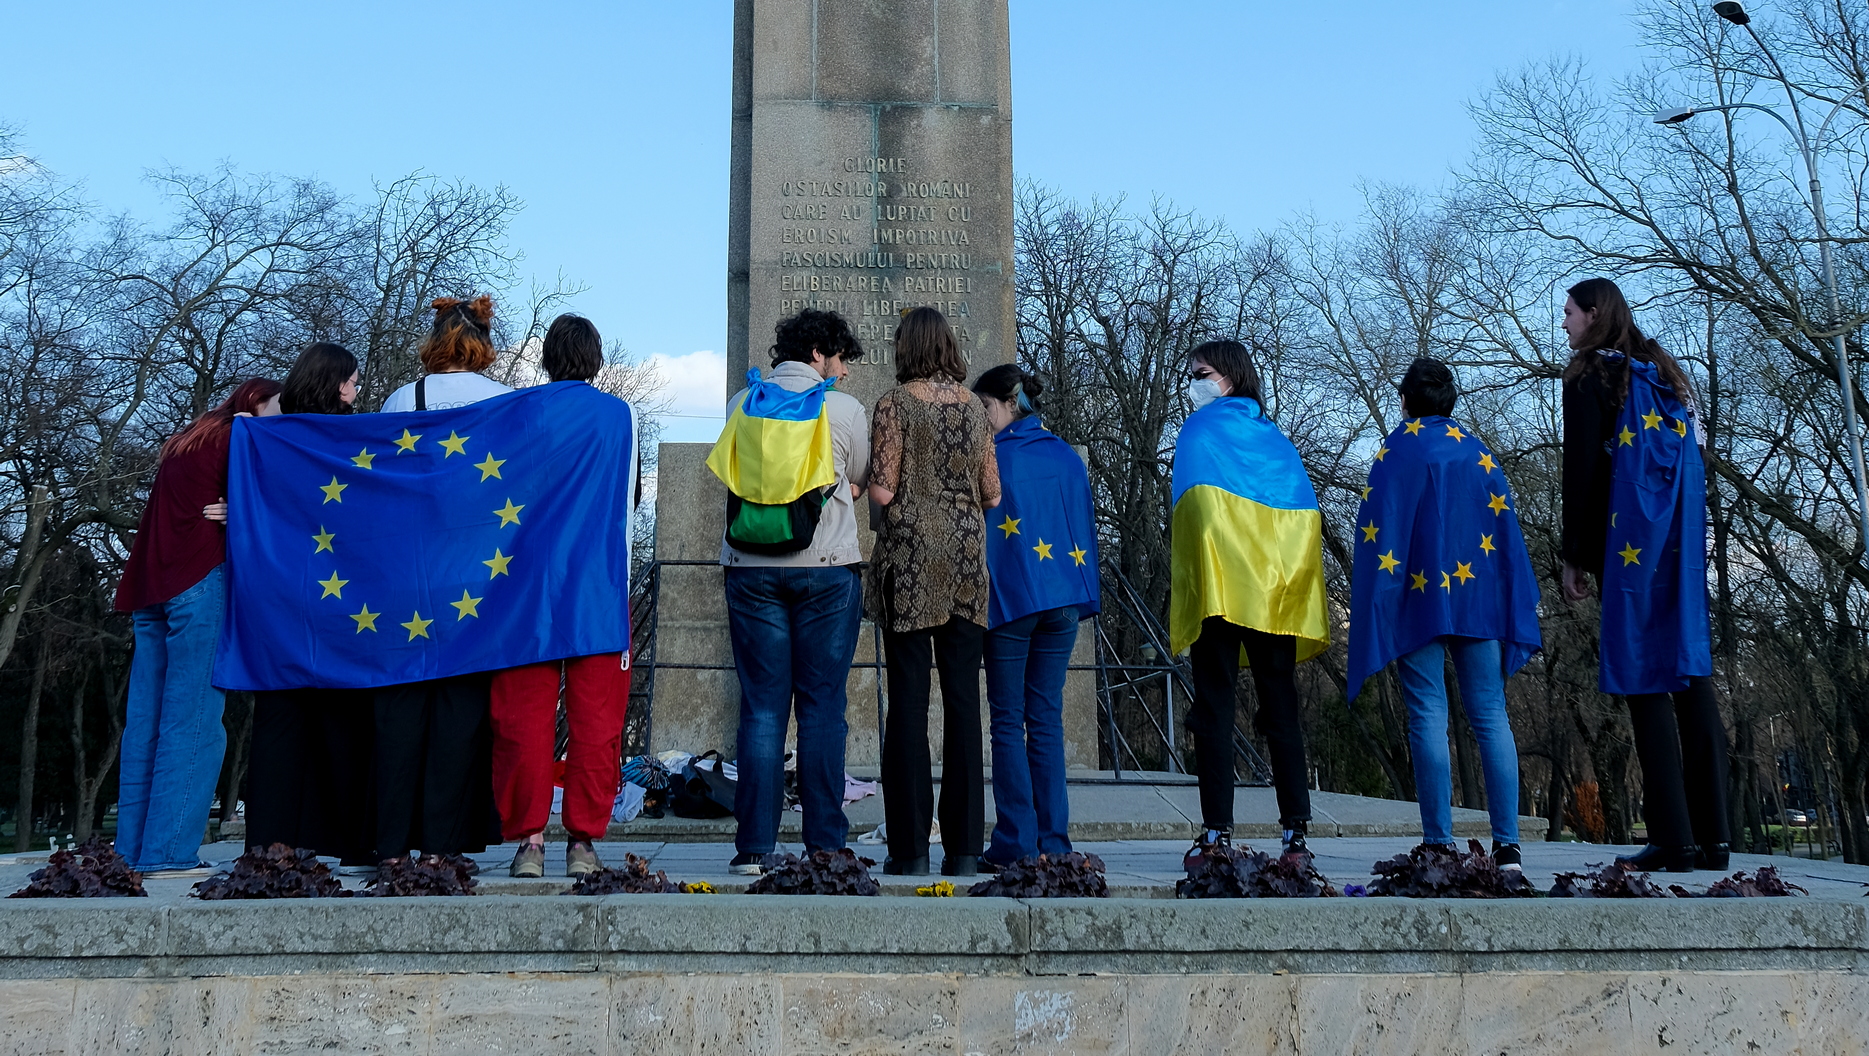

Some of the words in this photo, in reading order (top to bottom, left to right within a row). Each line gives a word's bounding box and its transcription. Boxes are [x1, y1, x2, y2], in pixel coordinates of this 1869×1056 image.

[844, 157, 906, 173] GLORIE
[782, 205, 827, 220] CARE
[840, 206, 862, 221] AU
[877, 206, 936, 221] LUPTAT
[947, 207, 971, 222] CU
[782, 228, 852, 244] EROISM
[872, 229, 970, 245] IMPOTRIVA
[782, 252, 893, 269] FASCISMULUI
[906, 253, 971, 270] PENTRU
[781, 276, 893, 293] ELIBERAREA
[904, 276, 971, 294] PATRIEI
